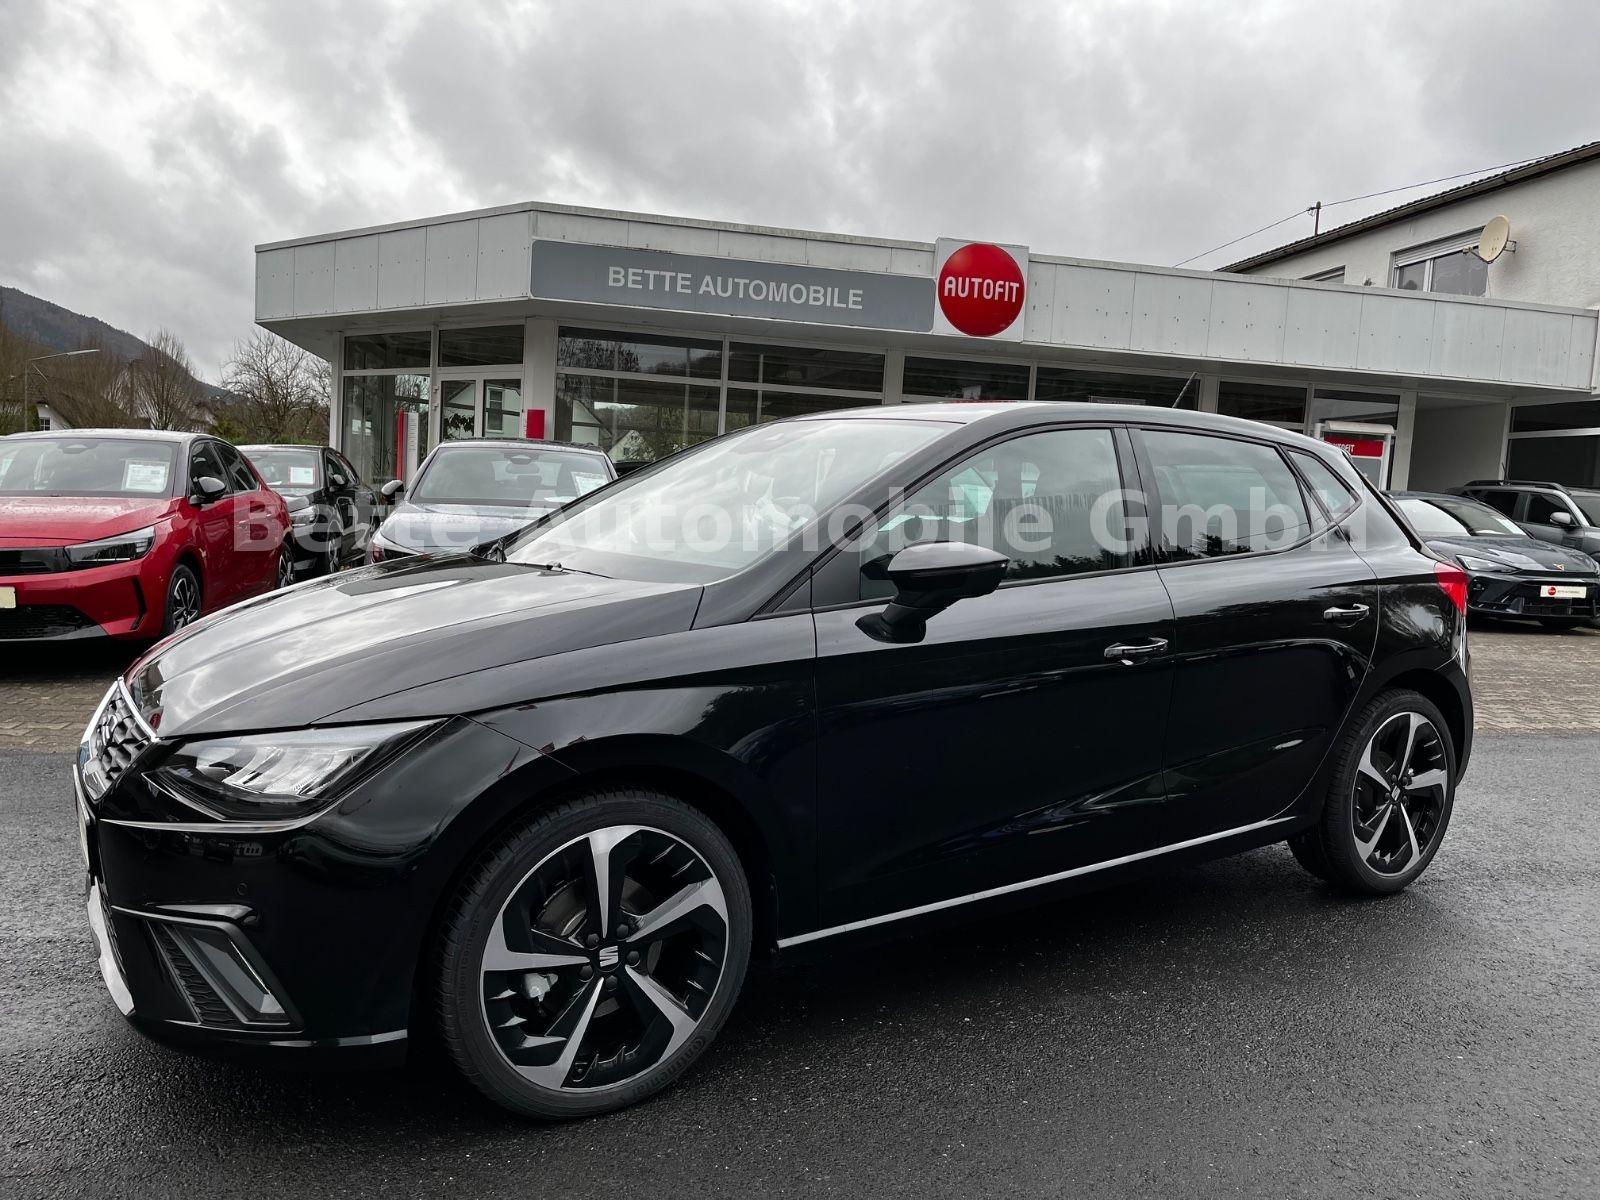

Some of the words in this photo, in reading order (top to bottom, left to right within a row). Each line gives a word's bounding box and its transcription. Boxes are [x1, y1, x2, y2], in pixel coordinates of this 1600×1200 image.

[608, 266, 692, 294] BETTE
[698, 275, 864, 310] AUTOMOBILE
[944, 276, 1020, 303] AUTOFIT
[631, 1038, 705, 1097] Continental
